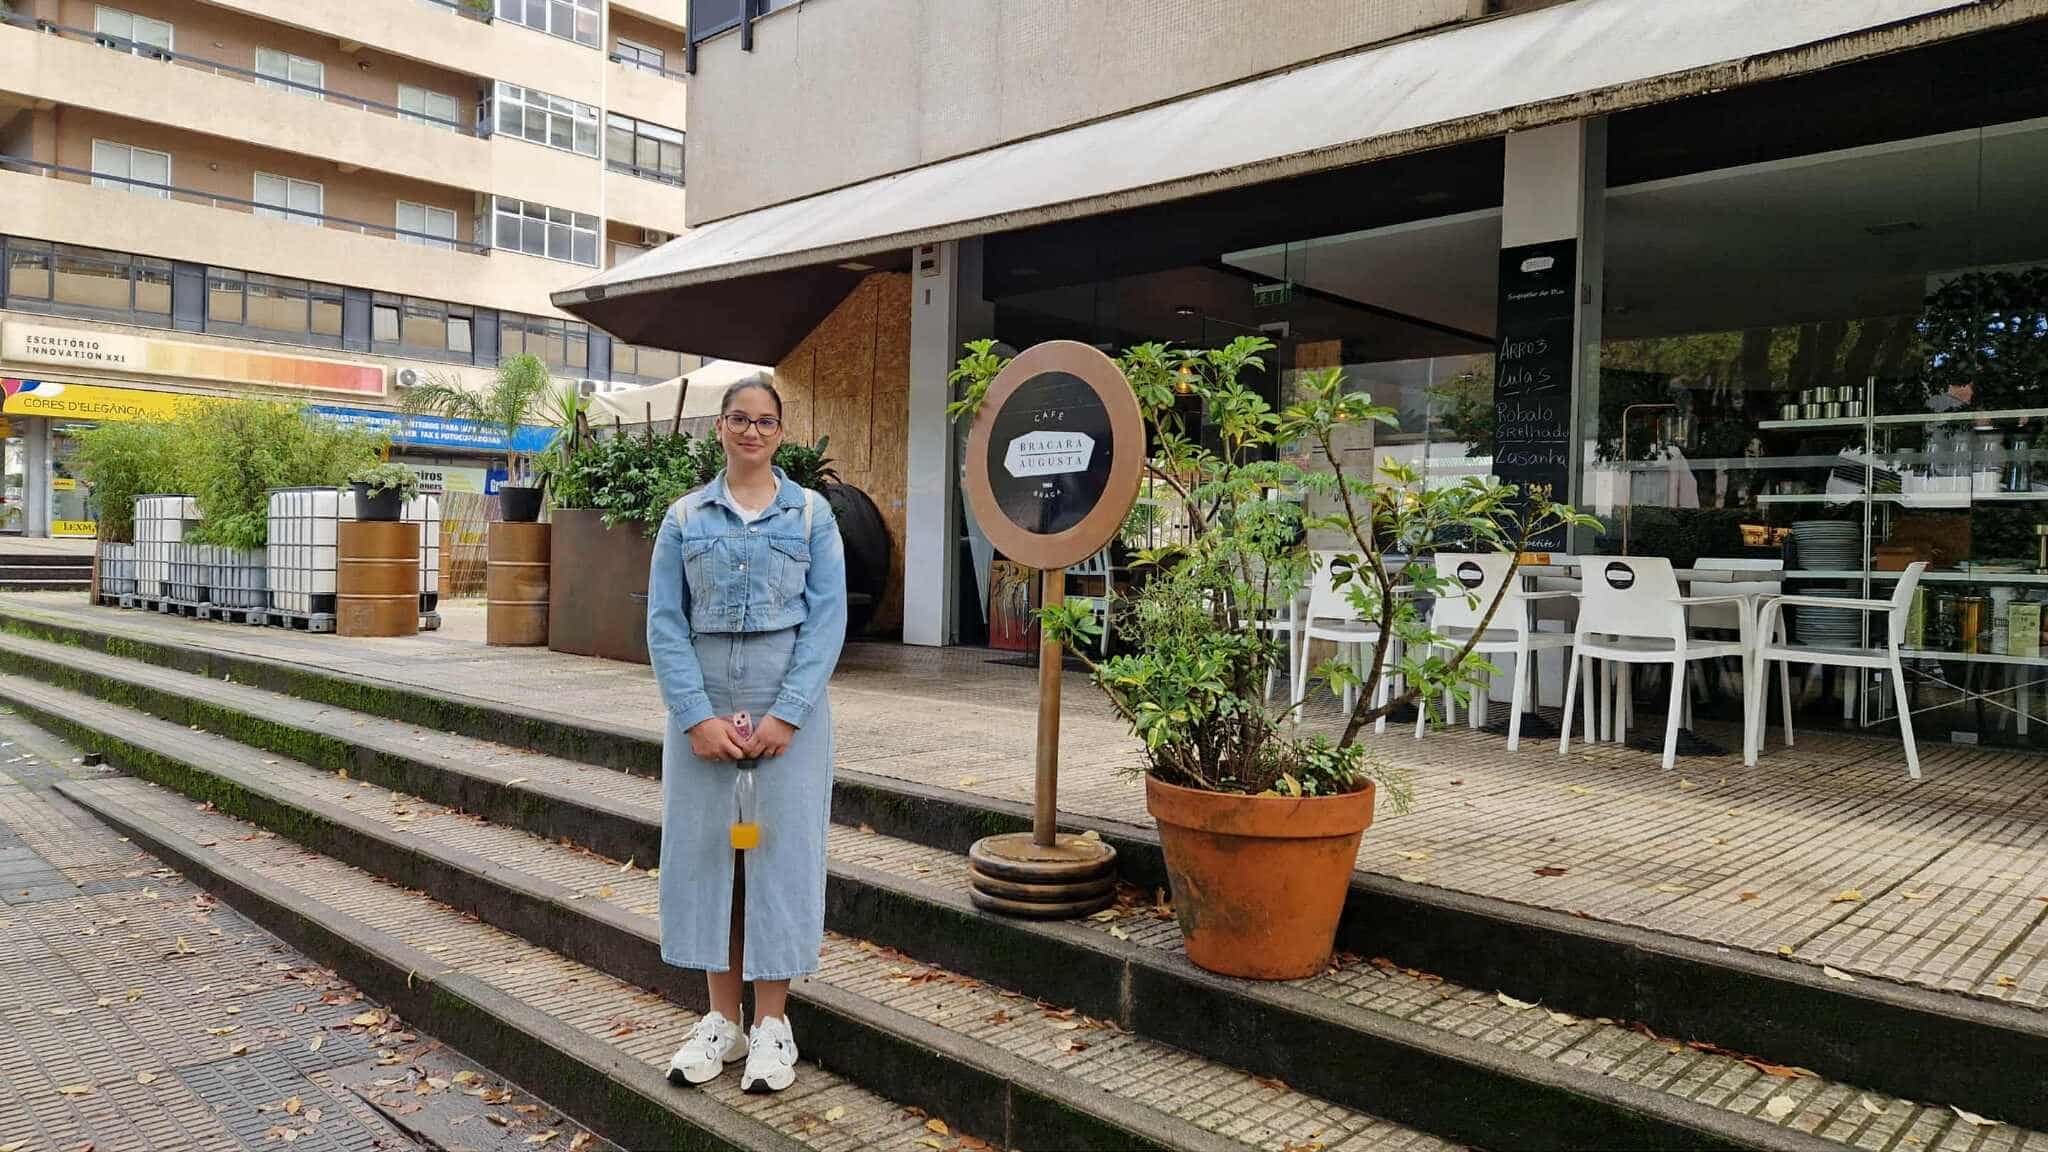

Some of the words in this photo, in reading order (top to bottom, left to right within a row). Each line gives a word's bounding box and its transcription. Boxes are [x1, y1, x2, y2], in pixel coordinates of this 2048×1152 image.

[26, 346, 102, 360] INNOVATION
[106, 354, 125, 363] XXI
[23, 398, 65, 410] CORES
[1020, 439, 1083, 452] BRACARA
[1020, 455, 1083, 468] AUGUSTA
[63, 521, 97, 533] LEXM
